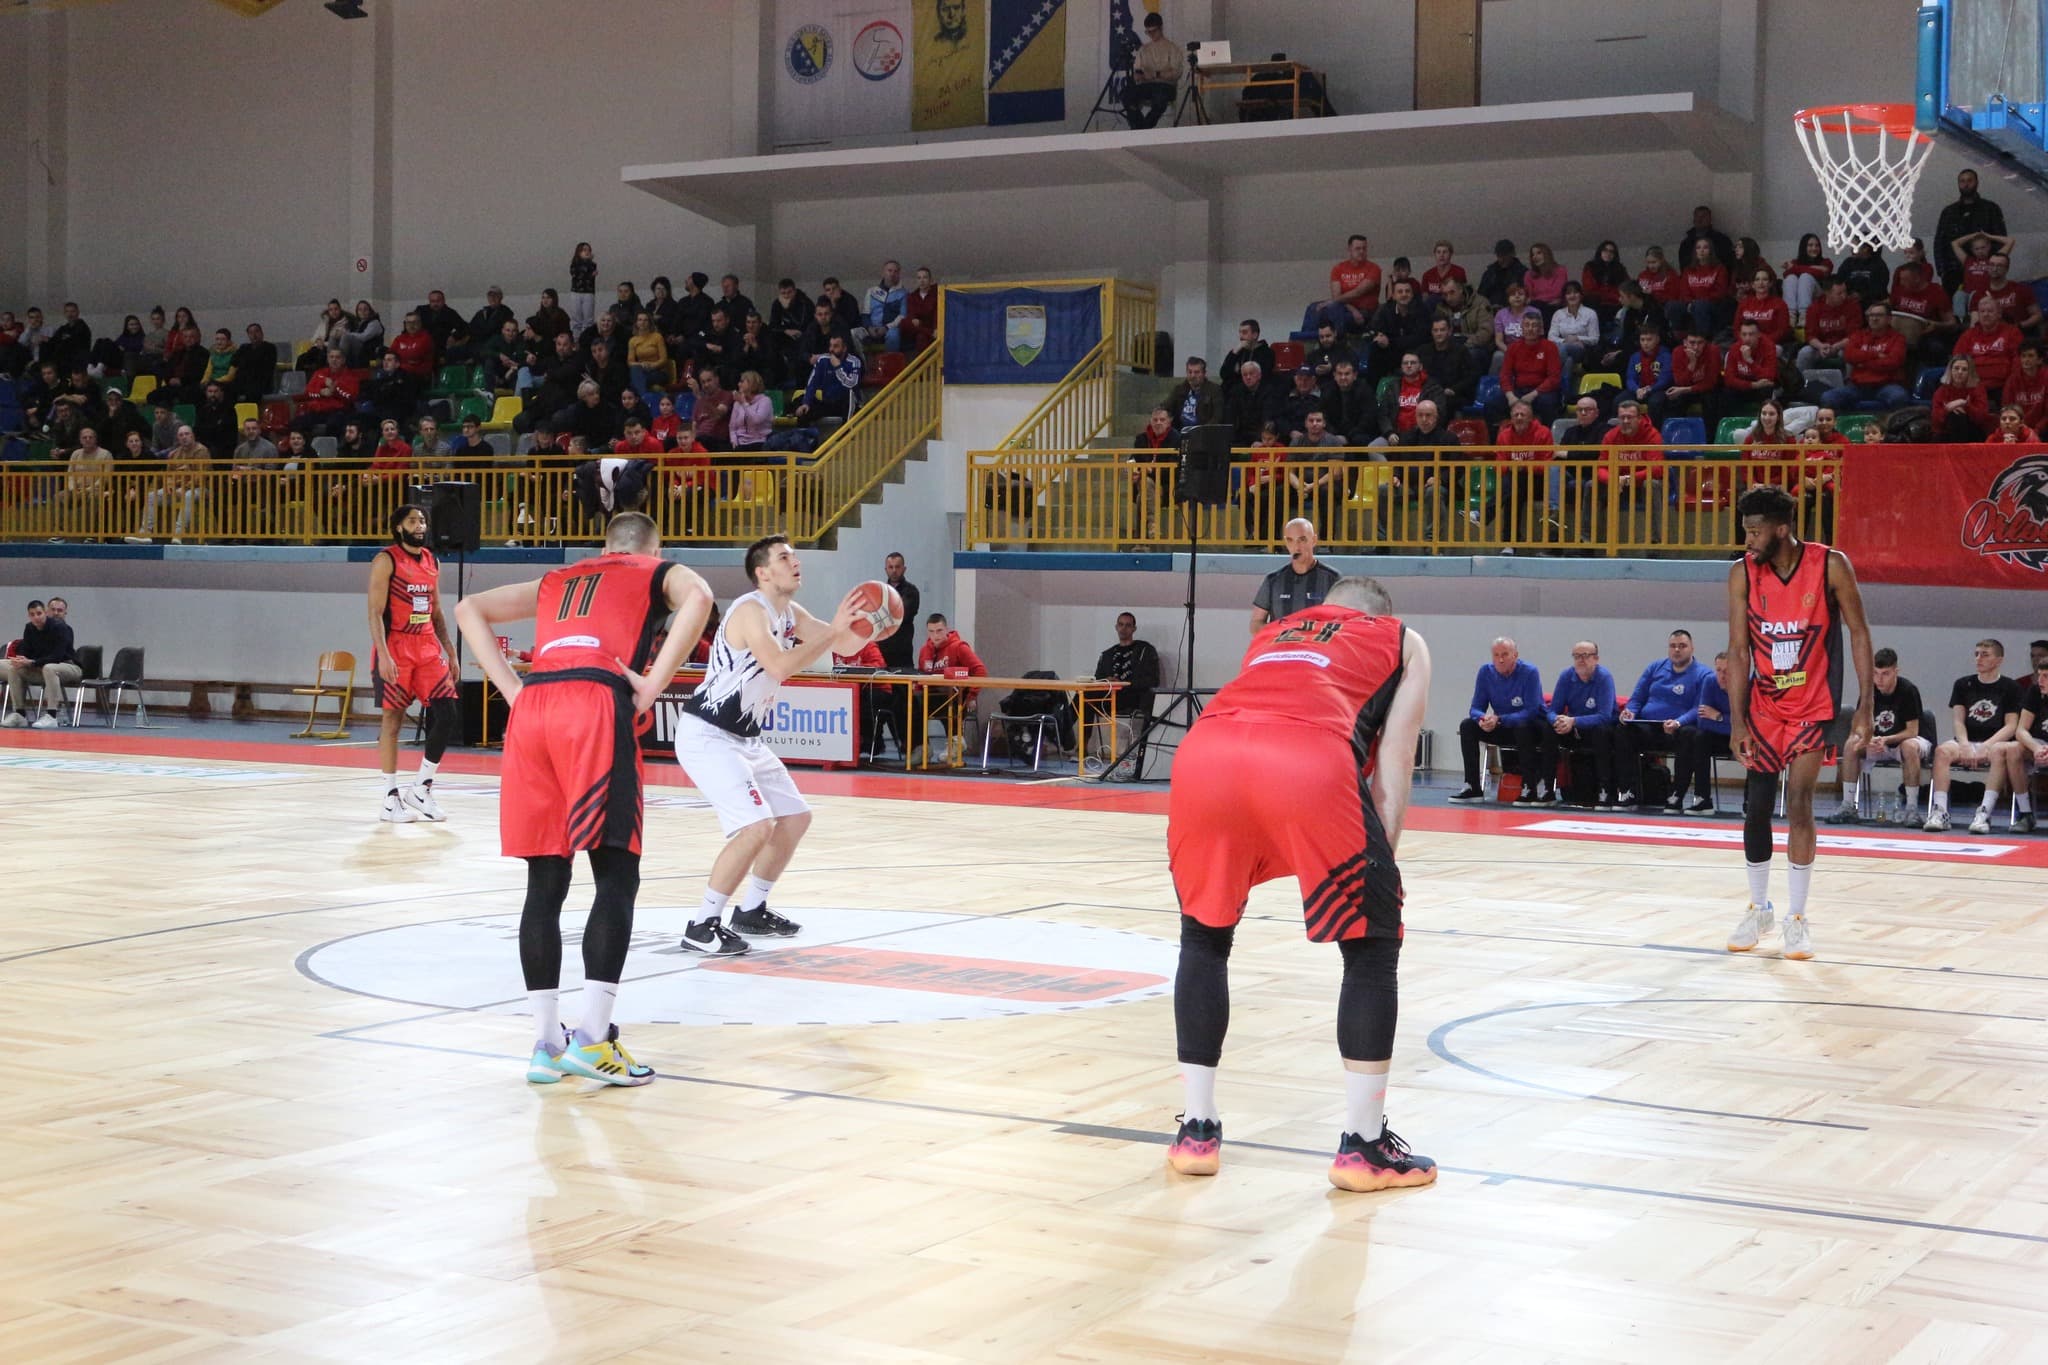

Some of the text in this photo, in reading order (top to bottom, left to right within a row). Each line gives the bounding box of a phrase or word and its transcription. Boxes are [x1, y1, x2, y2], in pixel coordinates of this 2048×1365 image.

[407, 584, 428, 593] PAN
[556, 572, 604, 622] 11
[1274, 619, 1343, 643] 21
[1760, 620, 1798, 635] PAN
[760, 735, 822, 747] SOLUTIONS
[749, 789, 763, 806] 3
